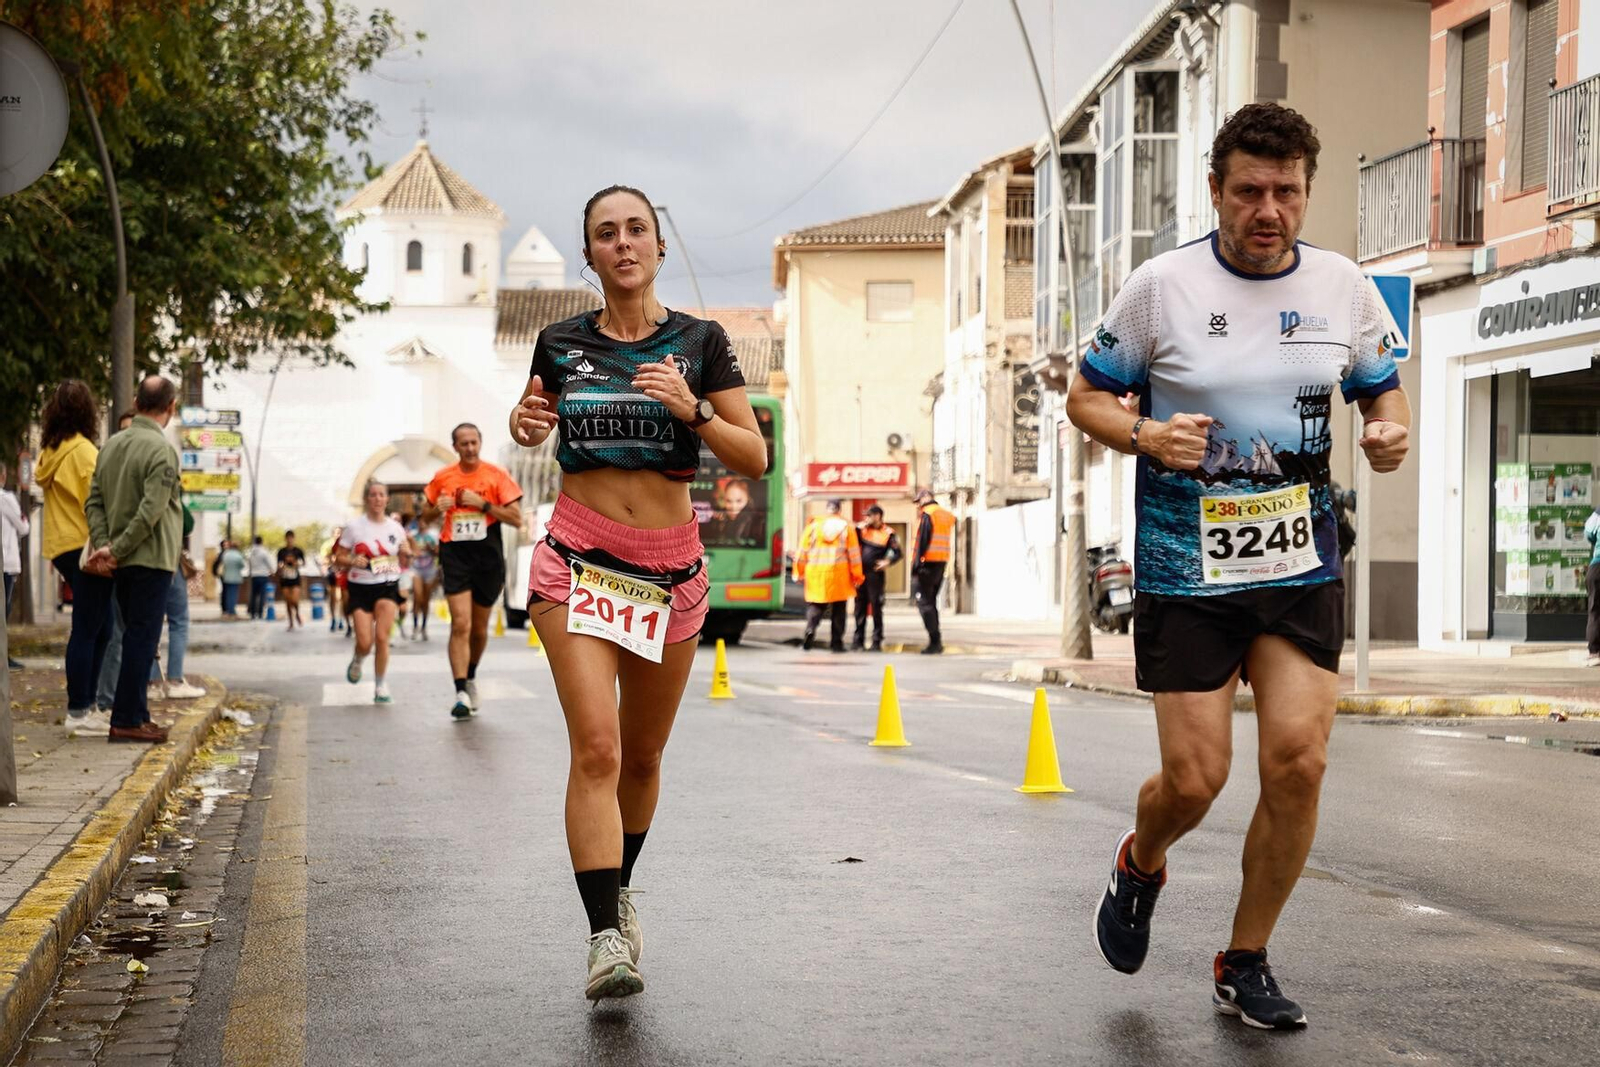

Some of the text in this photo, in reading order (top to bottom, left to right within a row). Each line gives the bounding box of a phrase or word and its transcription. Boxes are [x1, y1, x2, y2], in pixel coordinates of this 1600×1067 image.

[1300, 316, 1328, 327] HUELVA
[566, 372, 610, 383] Santander
[565, 403, 676, 418] XIX MEDIA MARATO
[565, 416, 676, 440] MÉRIDA
[841, 465, 901, 484] CEPSA
[1217, 497, 1293, 517] 38 FONDO
[1240, 498, 1262, 506] GRAN
[457, 522, 480, 534] 217
[1207, 516, 1310, 560] 3248
[583, 569, 652, 600] 38 FONDO
[604, 574, 649, 590] GRAN PREMIO
[572, 587, 660, 641] 2011
